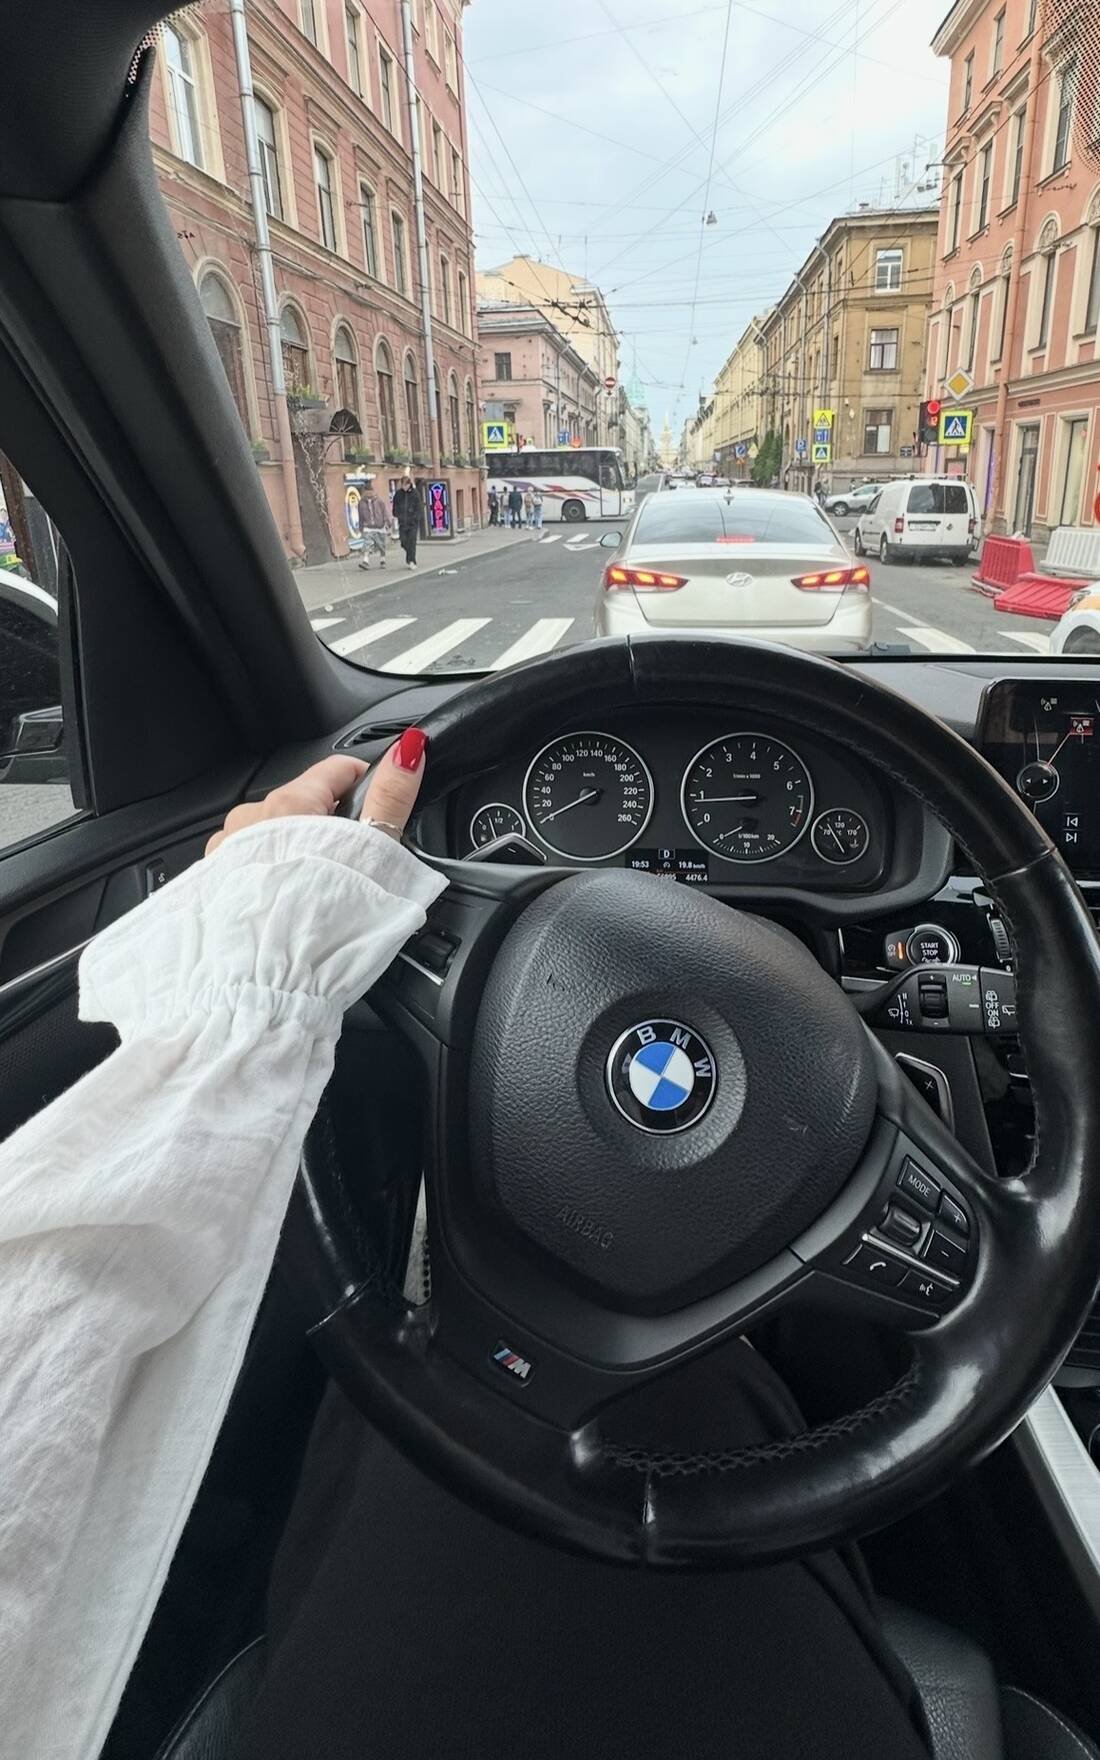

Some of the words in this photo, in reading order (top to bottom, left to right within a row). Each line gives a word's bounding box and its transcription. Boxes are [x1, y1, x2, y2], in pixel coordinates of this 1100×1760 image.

[576, 749, 589, 758] 120
[590, 749, 603, 758] 140
[726, 753, 732, 763] 3
[750, 752, 756, 760] 4
[562, 754, 575, 763] 100
[604, 755, 617, 763] 160
[552, 763, 562, 771] 80
[614, 764, 627, 772] 180
[773, 761, 780, 771] 5
[544, 773, 555, 782] 60
[706, 768, 713, 778] 2
[619, 775, 634, 783] 200
[541, 786, 551, 794] 40
[786, 781, 793, 791] 6
[623, 788, 638, 796] 220
[700, 791, 705, 800] 1
[542, 800, 552, 808] 20
[622, 801, 637, 809] 240
[789, 806, 795, 816] 7
[617, 814, 632, 823] 260
[703, 813, 710, 822] 0
[663, 849, 670, 859] D
[631, 860, 650, 869] 19:53
[678, 861, 693, 869] 19.8
[685, 873, 708, 882] 4476.4
[952, 974, 971, 982] AUTO
[985, 1001, 999, 1010] OFF
[987, 1009, 999, 1017] ON
[636, 1025, 712, 1078] BMW
[908, 1174, 931, 1198] MODE
[560, 1206, 614, 1250] AIRBAG
